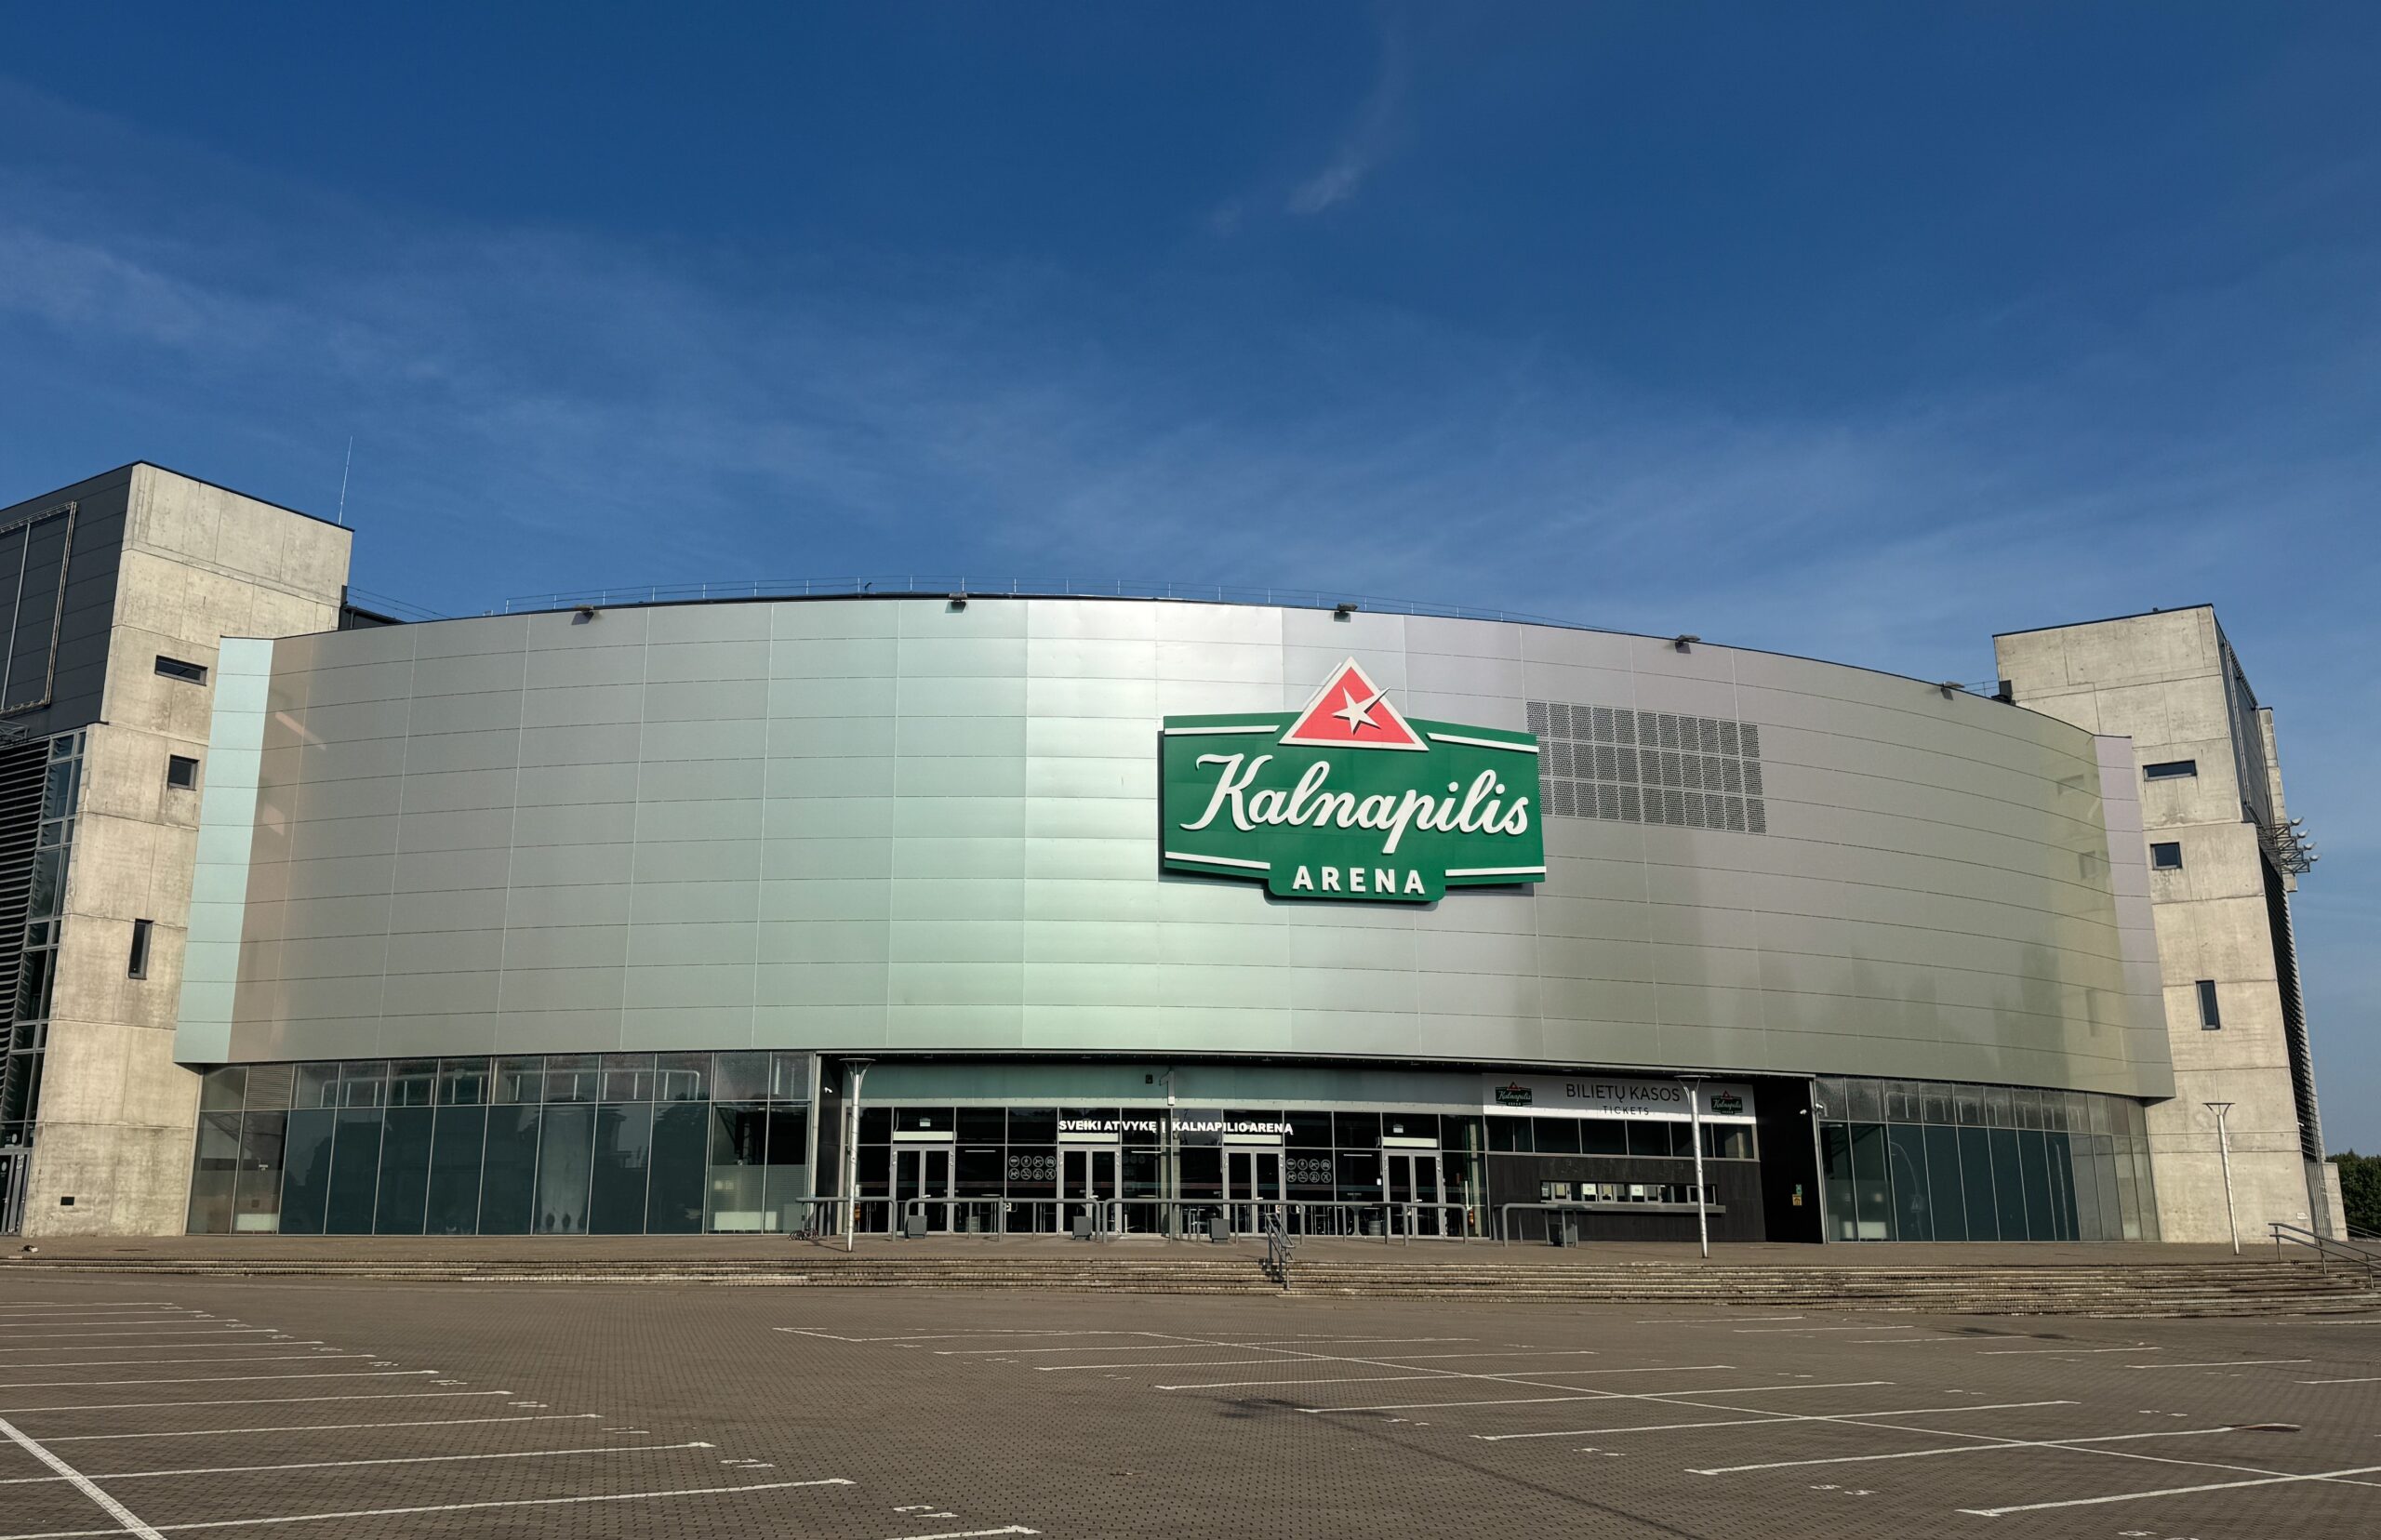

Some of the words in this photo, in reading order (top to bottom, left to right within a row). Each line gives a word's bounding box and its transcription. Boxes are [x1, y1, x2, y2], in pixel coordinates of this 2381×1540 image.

[1180, 753, 1528, 854] Kalnapilis
[1293, 866, 1425, 894] ARENA
[1566, 1083, 1625, 1103] BILIETŲ
[1630, 1086, 1680, 1102] KASOS
[1603, 1106, 1649, 1115] TICKETS
[1058, 1120, 1101, 1131] SVEIKI
[1172, 1122, 1246, 1133] KALNAPILIO
[1249, 1123, 1293, 1135] ARENĄ
